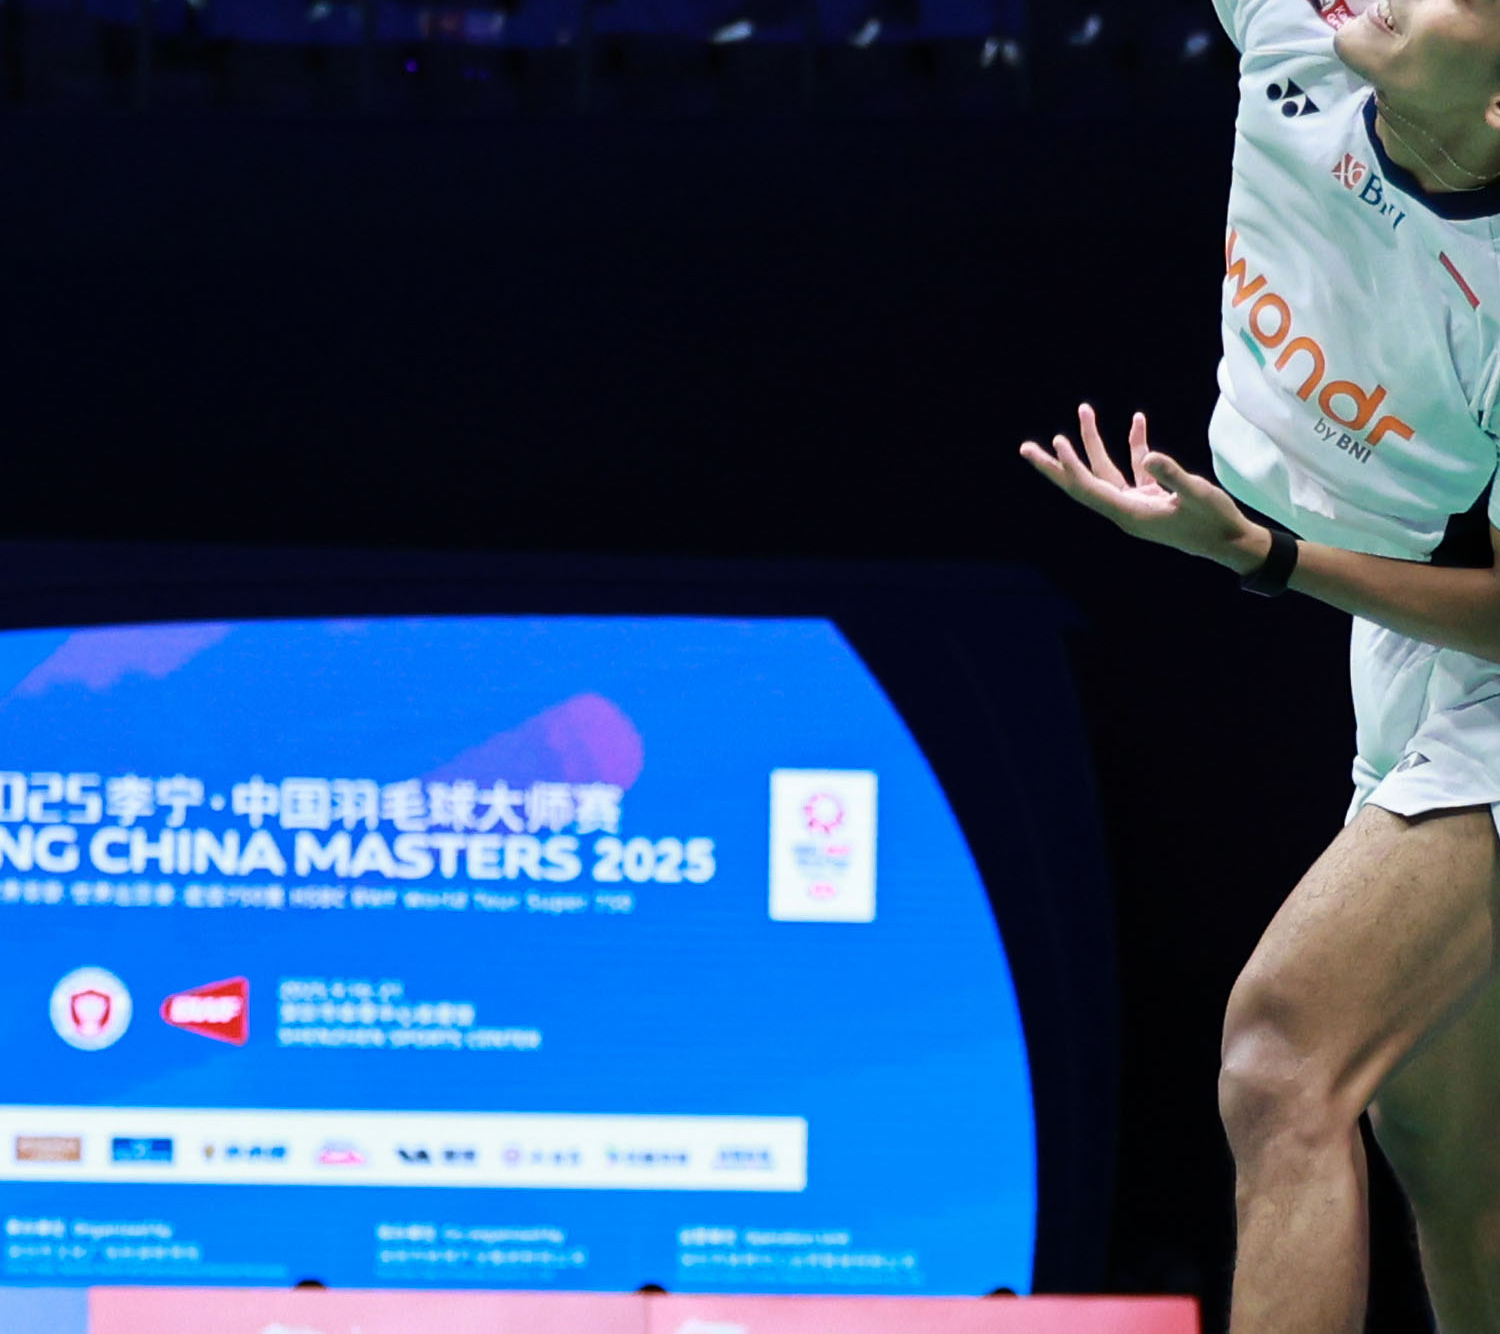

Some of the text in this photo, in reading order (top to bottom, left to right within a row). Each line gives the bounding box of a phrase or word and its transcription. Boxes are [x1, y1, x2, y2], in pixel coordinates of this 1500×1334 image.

[1225, 229, 1416, 445] wondr
[1313, 416, 1372, 464] by BNI
[89, 825, 286, 878] CHINA
[299, 830, 580, 882] MASTERS
[592, 836, 717, 884] 2025
